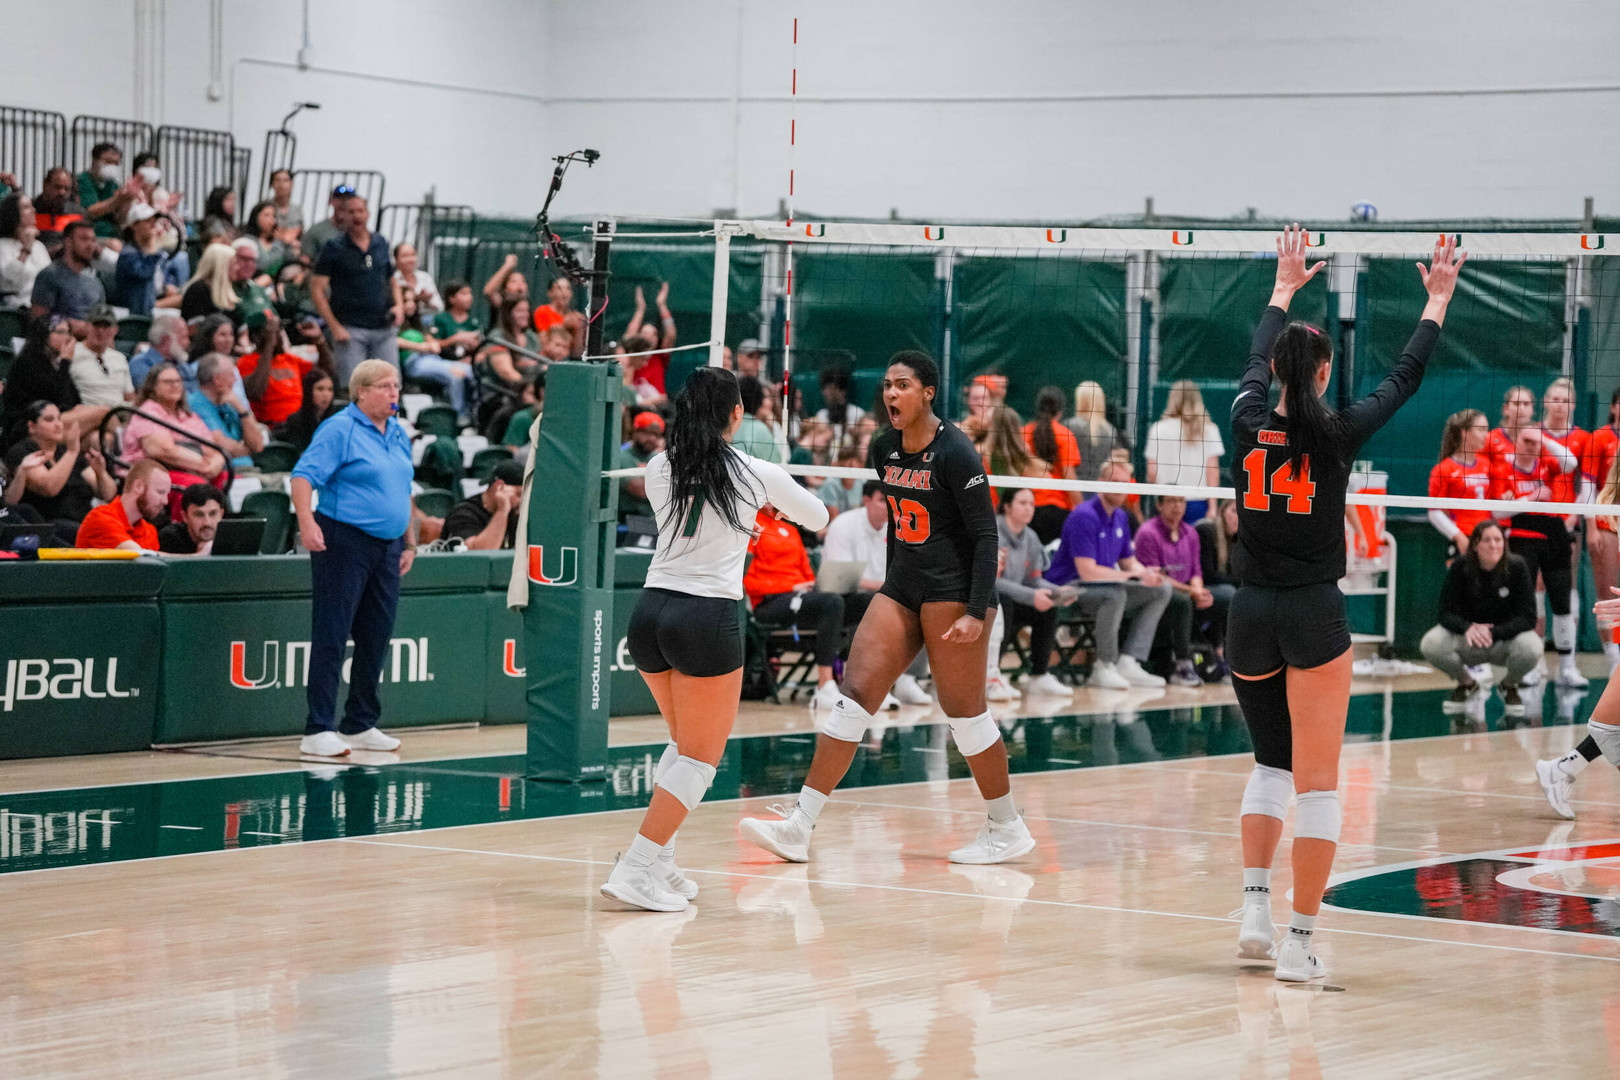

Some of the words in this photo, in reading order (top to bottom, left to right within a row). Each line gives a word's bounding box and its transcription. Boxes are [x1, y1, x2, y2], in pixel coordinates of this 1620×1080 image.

[964, 474, 985, 490] ACC
[1243, 448, 1316, 514] 14
[887, 495, 931, 544] 10
[527, 544, 578, 587] U
[594, 609, 602, 654] sports
[591, 656, 601, 710] imports
